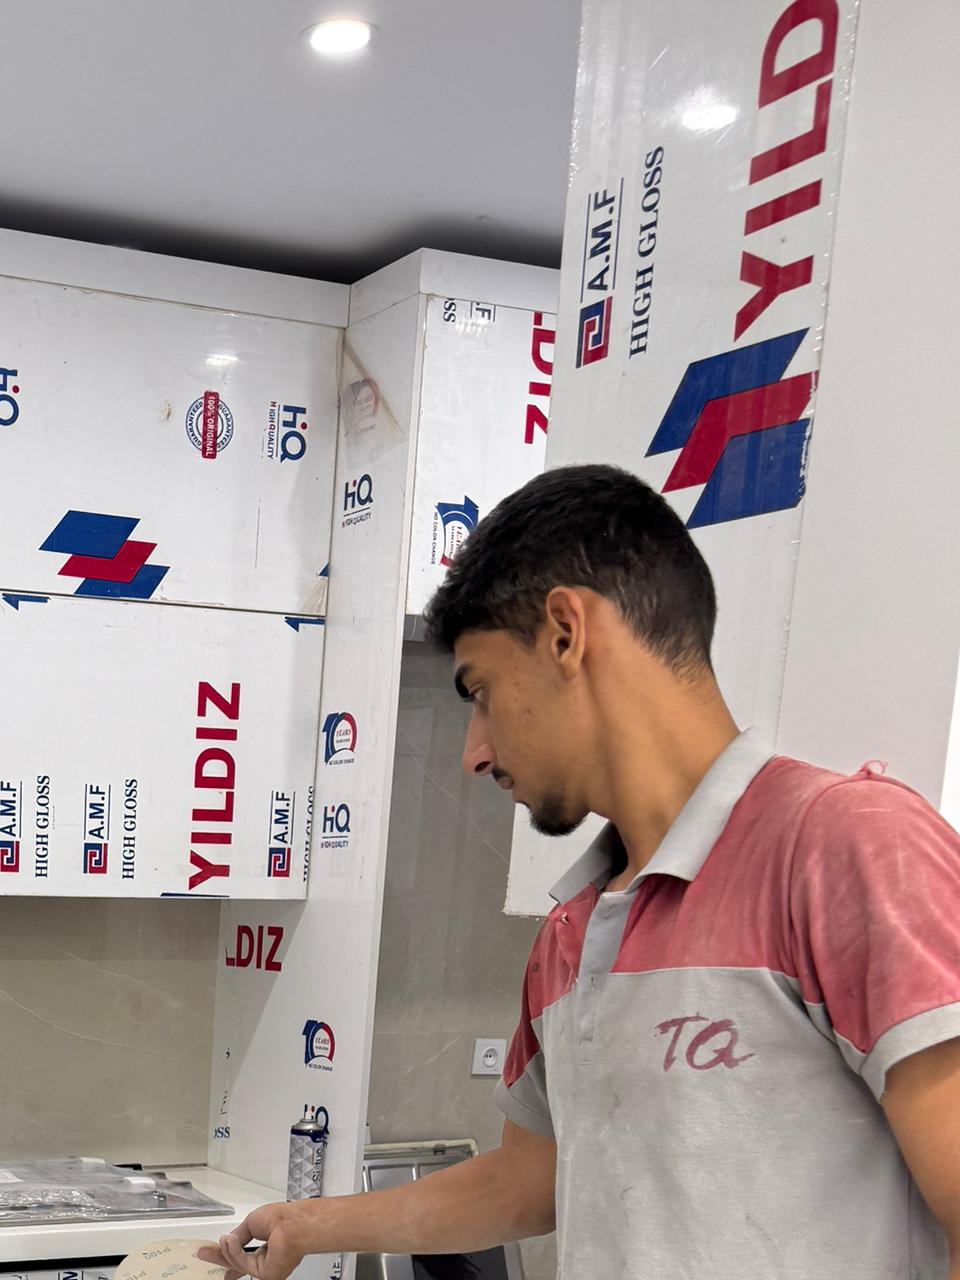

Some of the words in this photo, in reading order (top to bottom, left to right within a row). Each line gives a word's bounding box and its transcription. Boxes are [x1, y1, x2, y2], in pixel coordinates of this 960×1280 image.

[734, 0, 839, 343] YILD
[638, 146, 664, 258] GLOSS
[629, 263, 655, 359] HIGH
[204, 417, 215, 457] ORIGINAL
[269, 401, 277, 424] HIGH
[267, 424, 276, 460] QUALITY
[0, 781, 17, 837] A.M.F
[36, 775, 50, 829] GLOSS
[88, 785, 106, 839] A.M.F
[123, 779, 138, 832] GLOSS
[188, 681, 241, 891] YILDIZ
[273, 792, 291, 844] A.M.F
[35, 834, 49, 878] HIGH
[122, 837, 136, 880] HIGH
